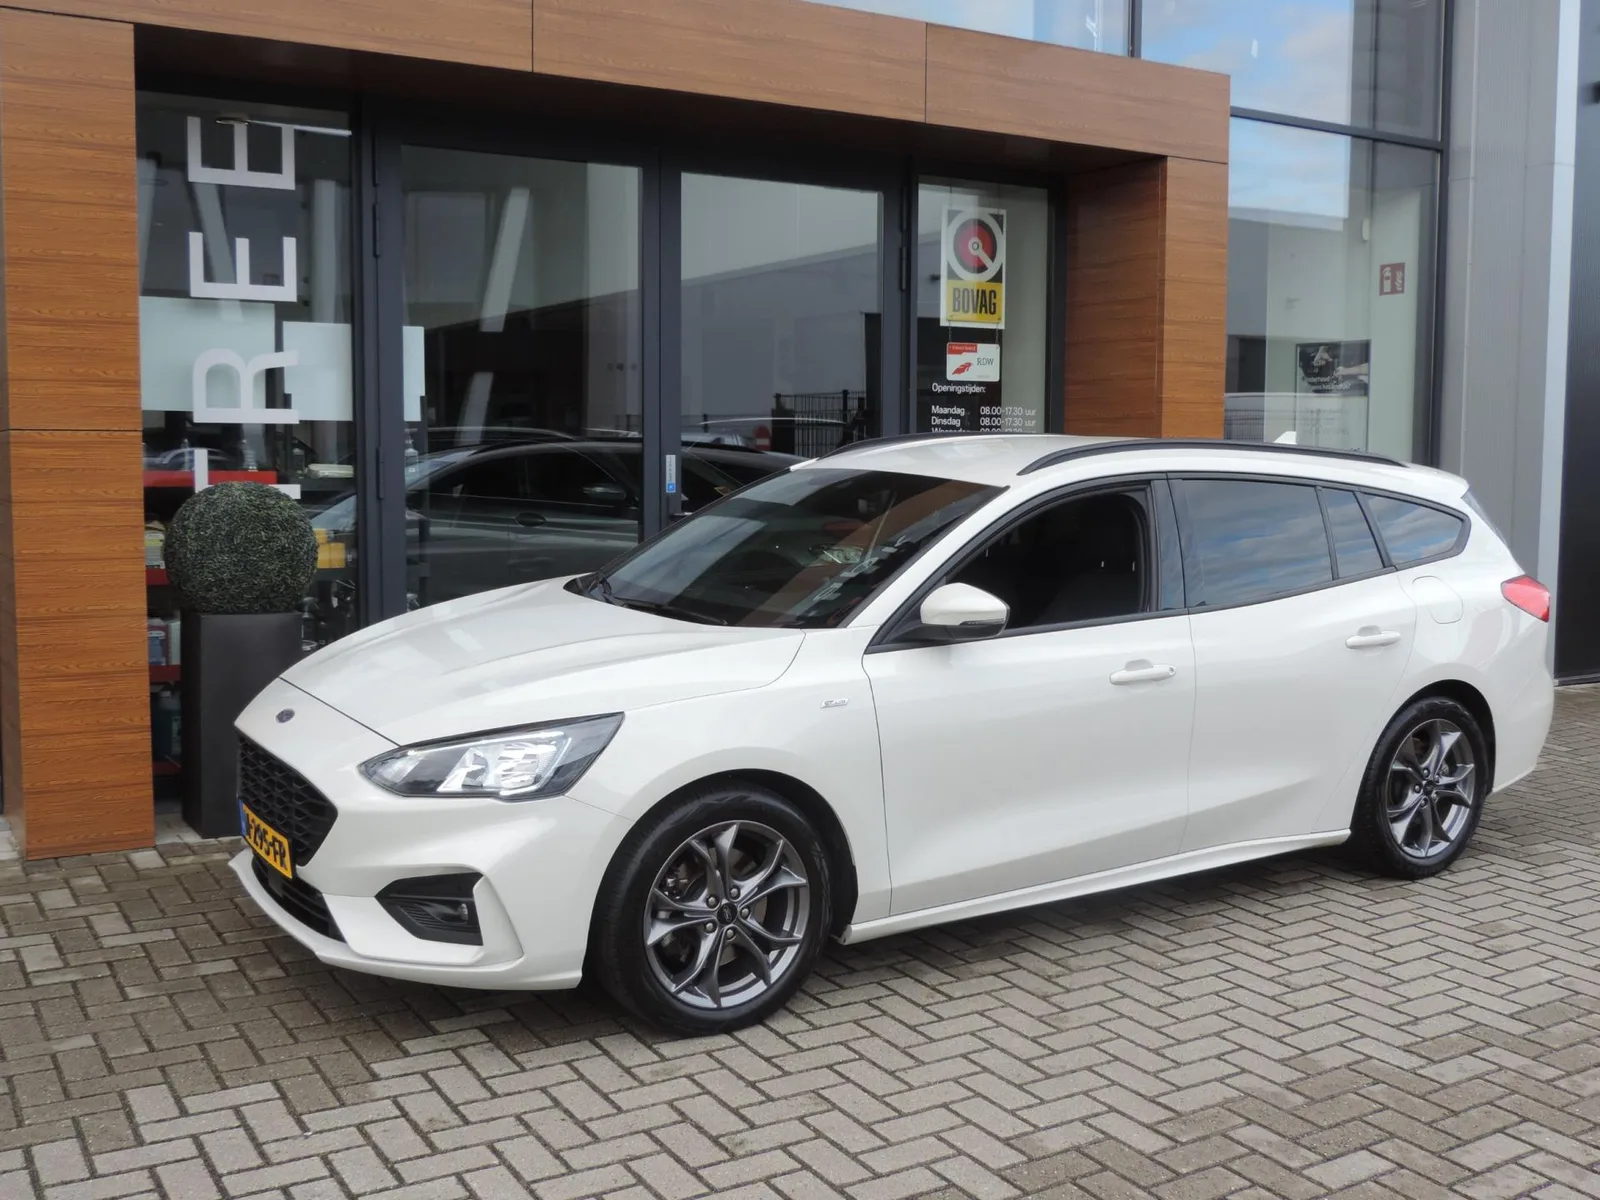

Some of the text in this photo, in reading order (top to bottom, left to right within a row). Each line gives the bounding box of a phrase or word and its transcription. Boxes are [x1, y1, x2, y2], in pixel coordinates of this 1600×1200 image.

[952, 287, 997, 315] BOVAG
[976, 357, 995, 366] RDW
[931, 382, 986, 394] Openingstijden:
[931, 405, 965, 416] Maandag
[931, 416, 961, 427] Dinsdag
